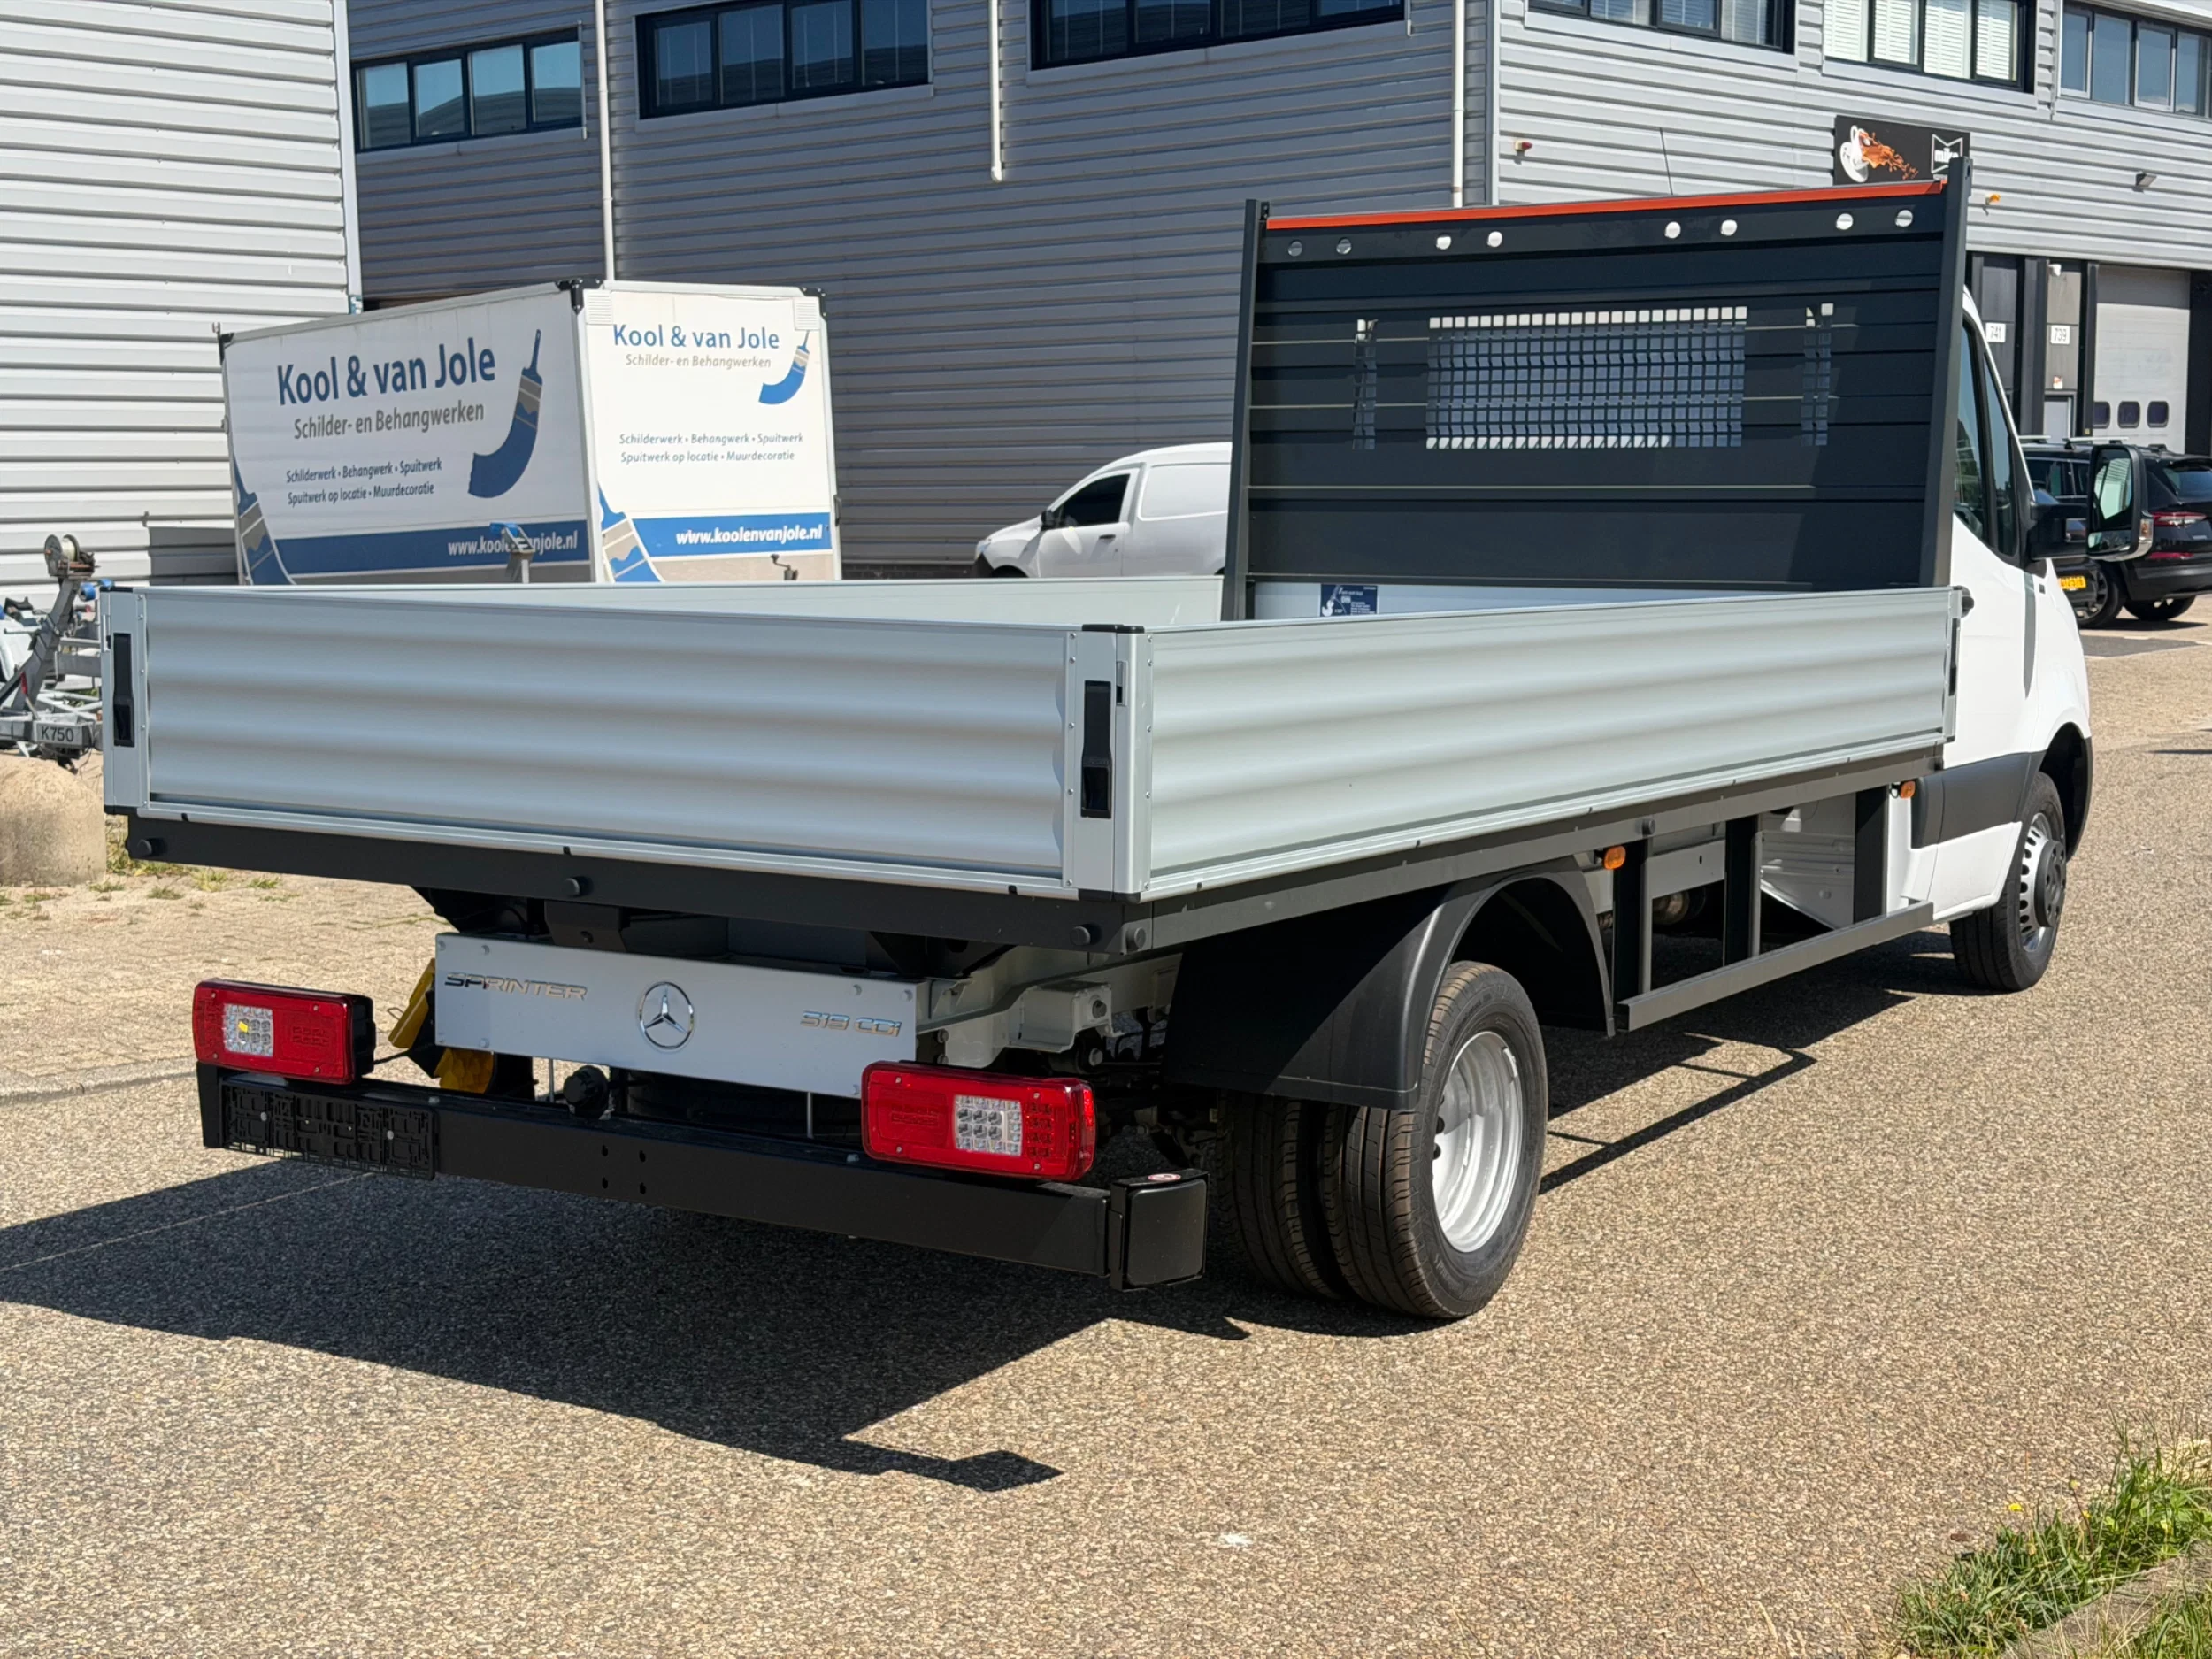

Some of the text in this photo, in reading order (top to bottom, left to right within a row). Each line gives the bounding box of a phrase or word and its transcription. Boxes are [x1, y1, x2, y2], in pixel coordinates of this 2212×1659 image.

[613, 324, 780, 349] Kool & van Jole
[1990, 325, 2002, 340] 741
[2054, 327, 2067, 342] 739
[277, 337, 495, 406] Kool & van Jole
[626, 354, 772, 370] Schilder- en Behangwerken
[294, 400, 484, 440] Schilder- en Behangwerken
[619, 433, 804, 446] Schilderwerk Behangwerk Spuitwerk
[621, 449, 795, 465] Spuitwerk op locatie Muurdecoratie
[287, 457, 442, 483] Schilderwerk Behangwerk Spuitwerk
[288, 481, 434, 508] Spuitwerk op locatie Muurdecoratie
[448, 530, 578, 556] www.koolnjole.nl
[676, 524, 823, 545] www.koolenvanjole.nl
[41, 726, 74, 742] K750
[444, 972, 588, 1001] SPRINTER
[853, 1017, 902, 1037] CDI
